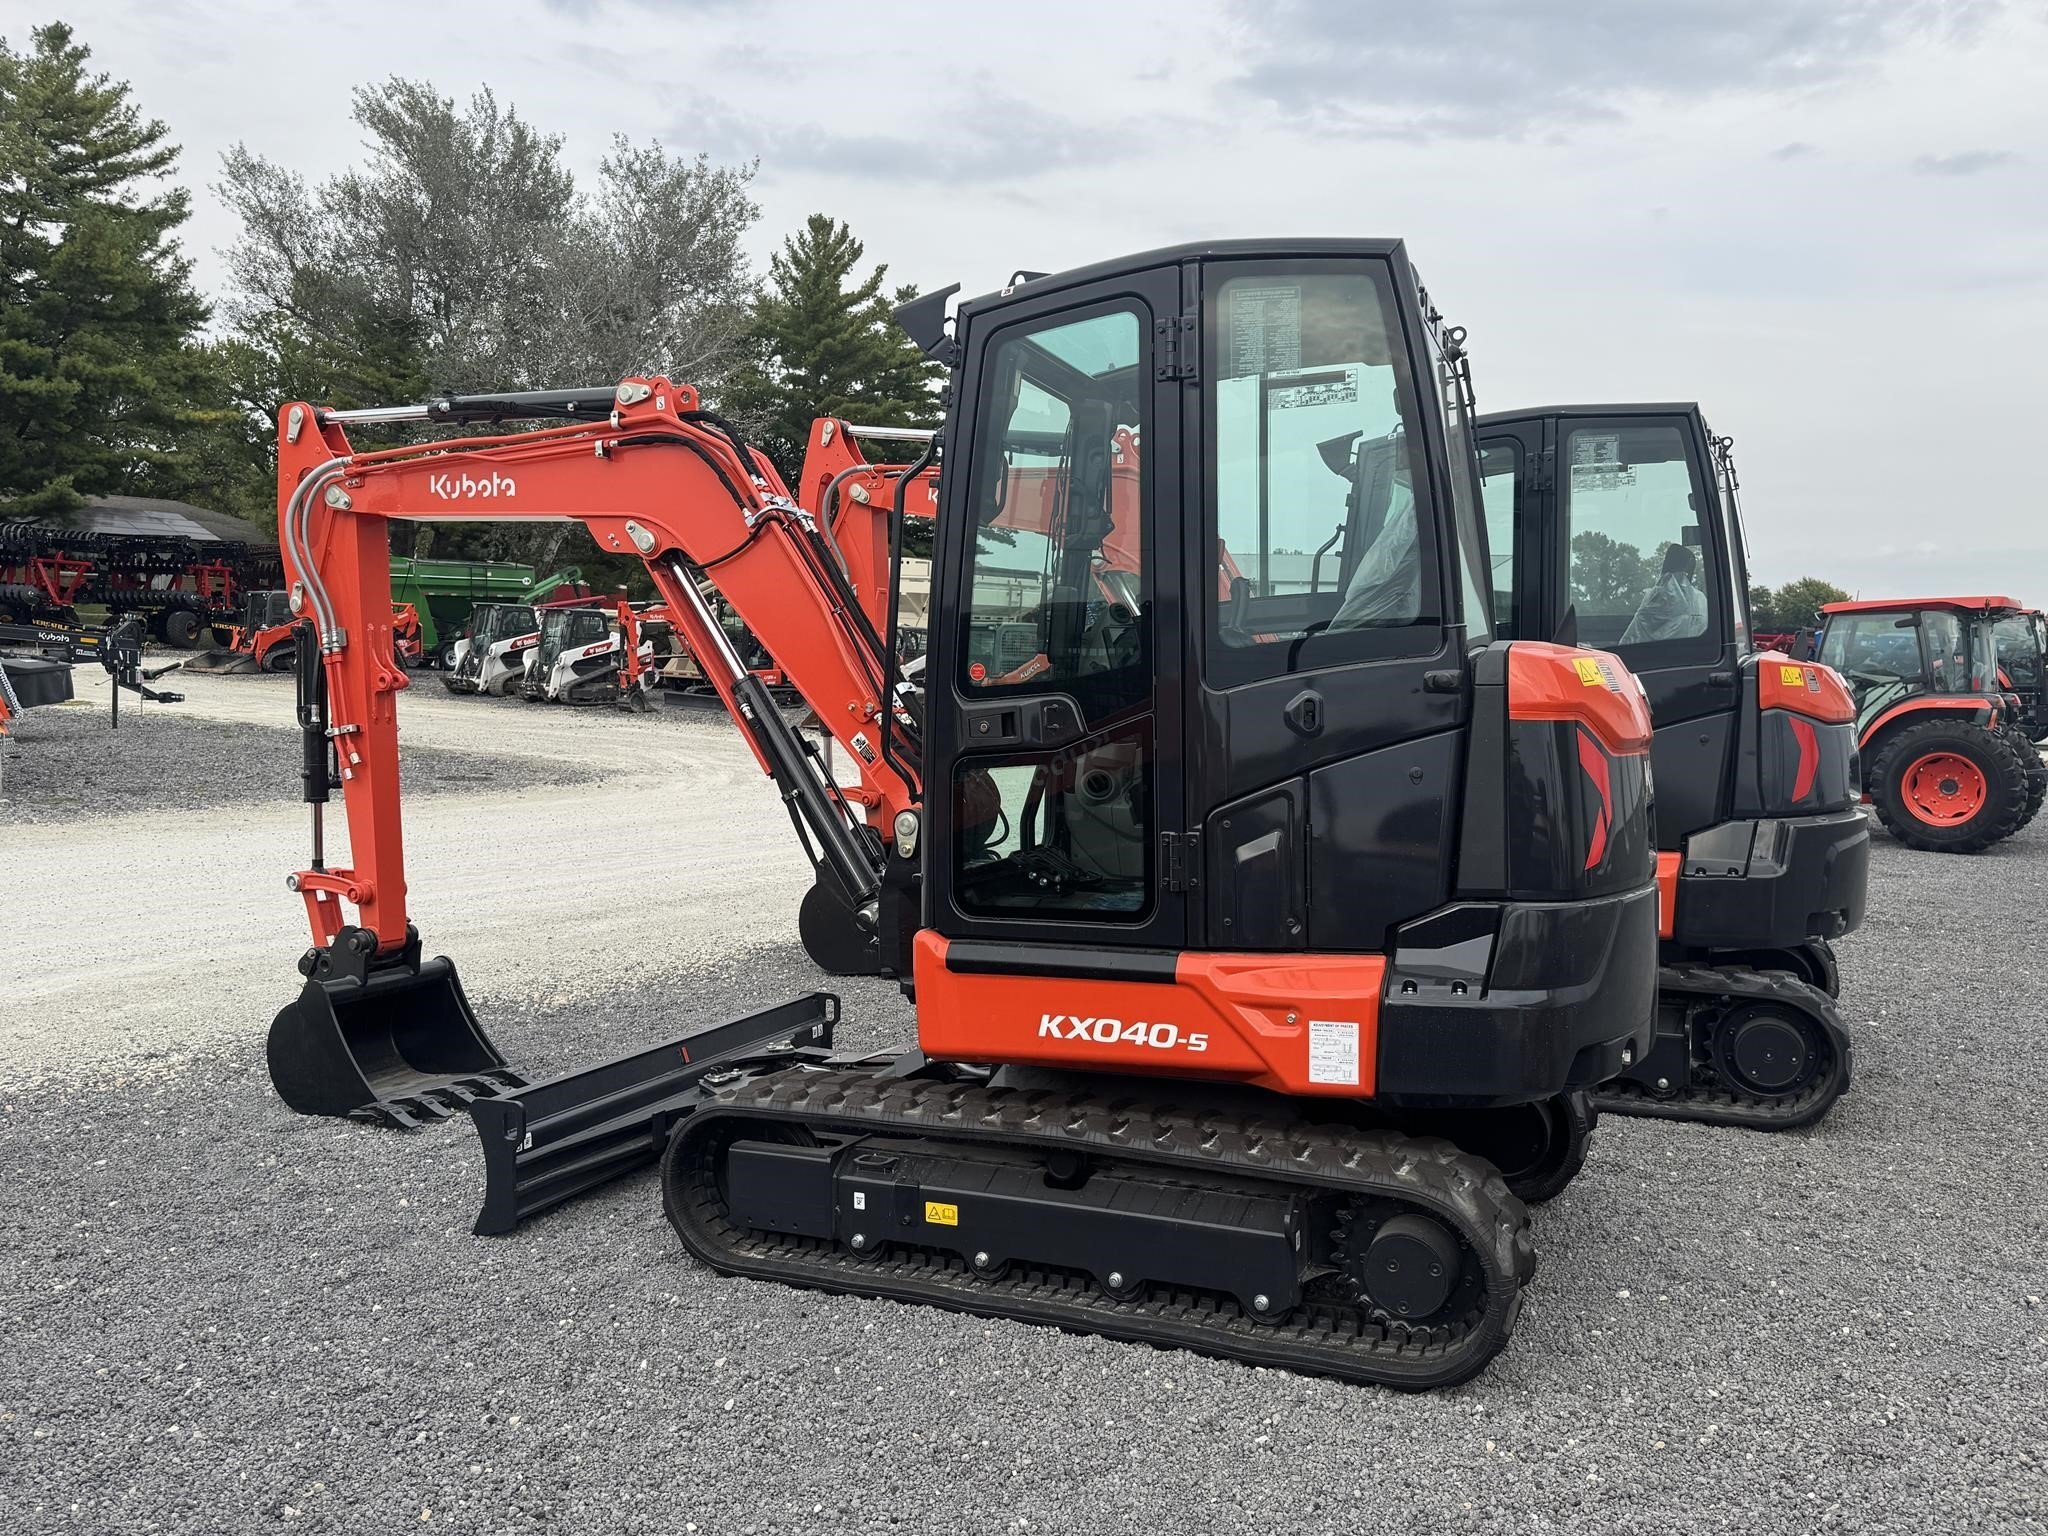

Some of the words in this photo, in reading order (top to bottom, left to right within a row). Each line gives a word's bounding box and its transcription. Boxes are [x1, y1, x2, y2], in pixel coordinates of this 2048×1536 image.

[430, 471, 516, 500] Kubota
[38, 631, 70, 642] Kubota
[1038, 1014, 1209, 1052] KX040-5
